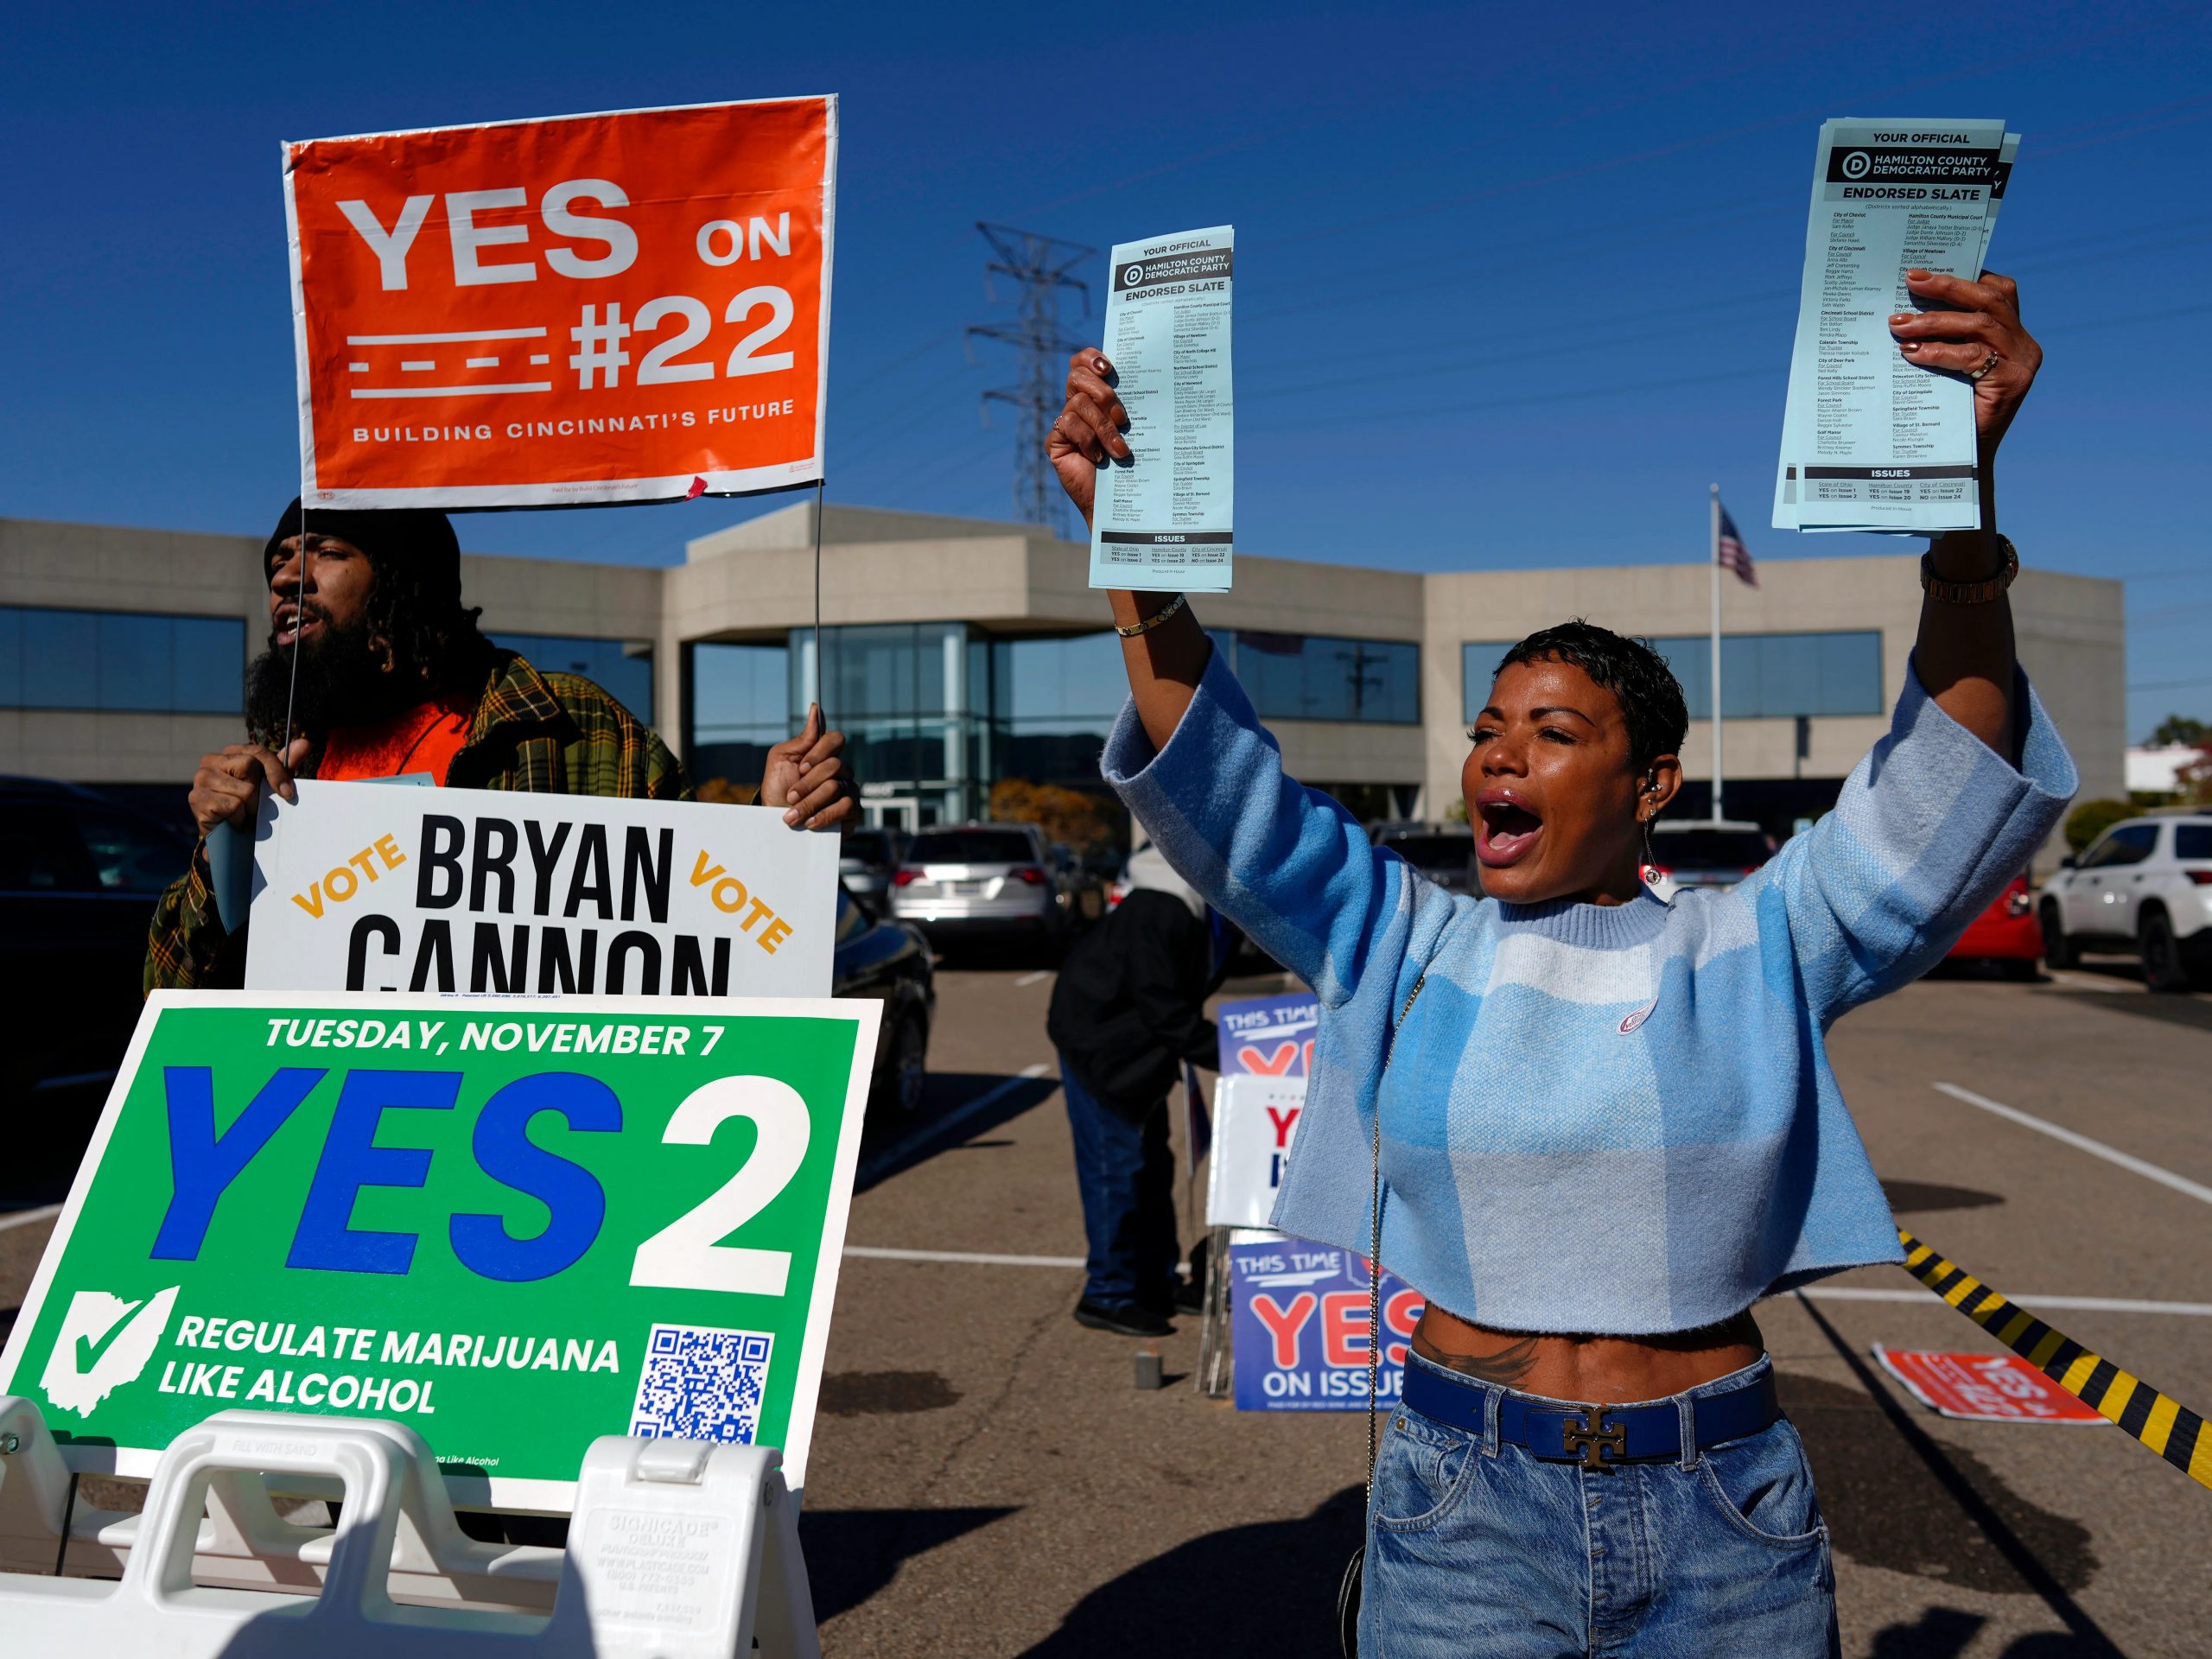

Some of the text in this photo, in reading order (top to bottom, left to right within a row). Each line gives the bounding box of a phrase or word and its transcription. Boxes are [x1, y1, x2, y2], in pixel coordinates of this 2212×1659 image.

[1873, 133, 1970, 143] YOUR OFFICIAL
[1872, 165, 1991, 176] DEMOCRATIC PARTY
[1875, 156, 1987, 166] HAMILTON COUNTY
[1843, 188, 1980, 200] ENDORSED SLATE
[334, 177, 791, 291] YES ON
[1143, 239, 1211, 256] YOUR OFFICIAL
[1145, 263, 1230, 280] DEMOCRATIC PARTY
[1146, 255, 1226, 272] HAMILTON COUNTY
[1126, 281, 1224, 301] ENDORSED SLATE
[569, 284, 795, 391] #22
[353, 397, 795, 443] BUILDING CINCINNATI'S FUTURE
[290, 832, 408, 920] VOTE
[416, 813, 674, 924] BRYAN
[689, 849, 794, 956] VOTE
[346, 914, 731, 996] CANNON
[1224, 1004, 1319, 1030] THIS TIME
[264, 1018, 724, 1057] TUESDAY, NOVEMBER 7
[149, 1065, 812, 1297] YES 2
[1235, 1251, 1341, 1276] THIS TIME
[1249, 1288, 1426, 1370] YES
[174, 1315, 620, 1375] REGULATE MARIJUANA
[158, 1360, 436, 1414] LIKE ALCOHOL
[1262, 1371, 1316, 1397] ON
[232, 1439, 317, 1456] FILL WITH SAND
[446, 1455, 464, 1464] Like
[465, 1456, 500, 1466] Alcohol
